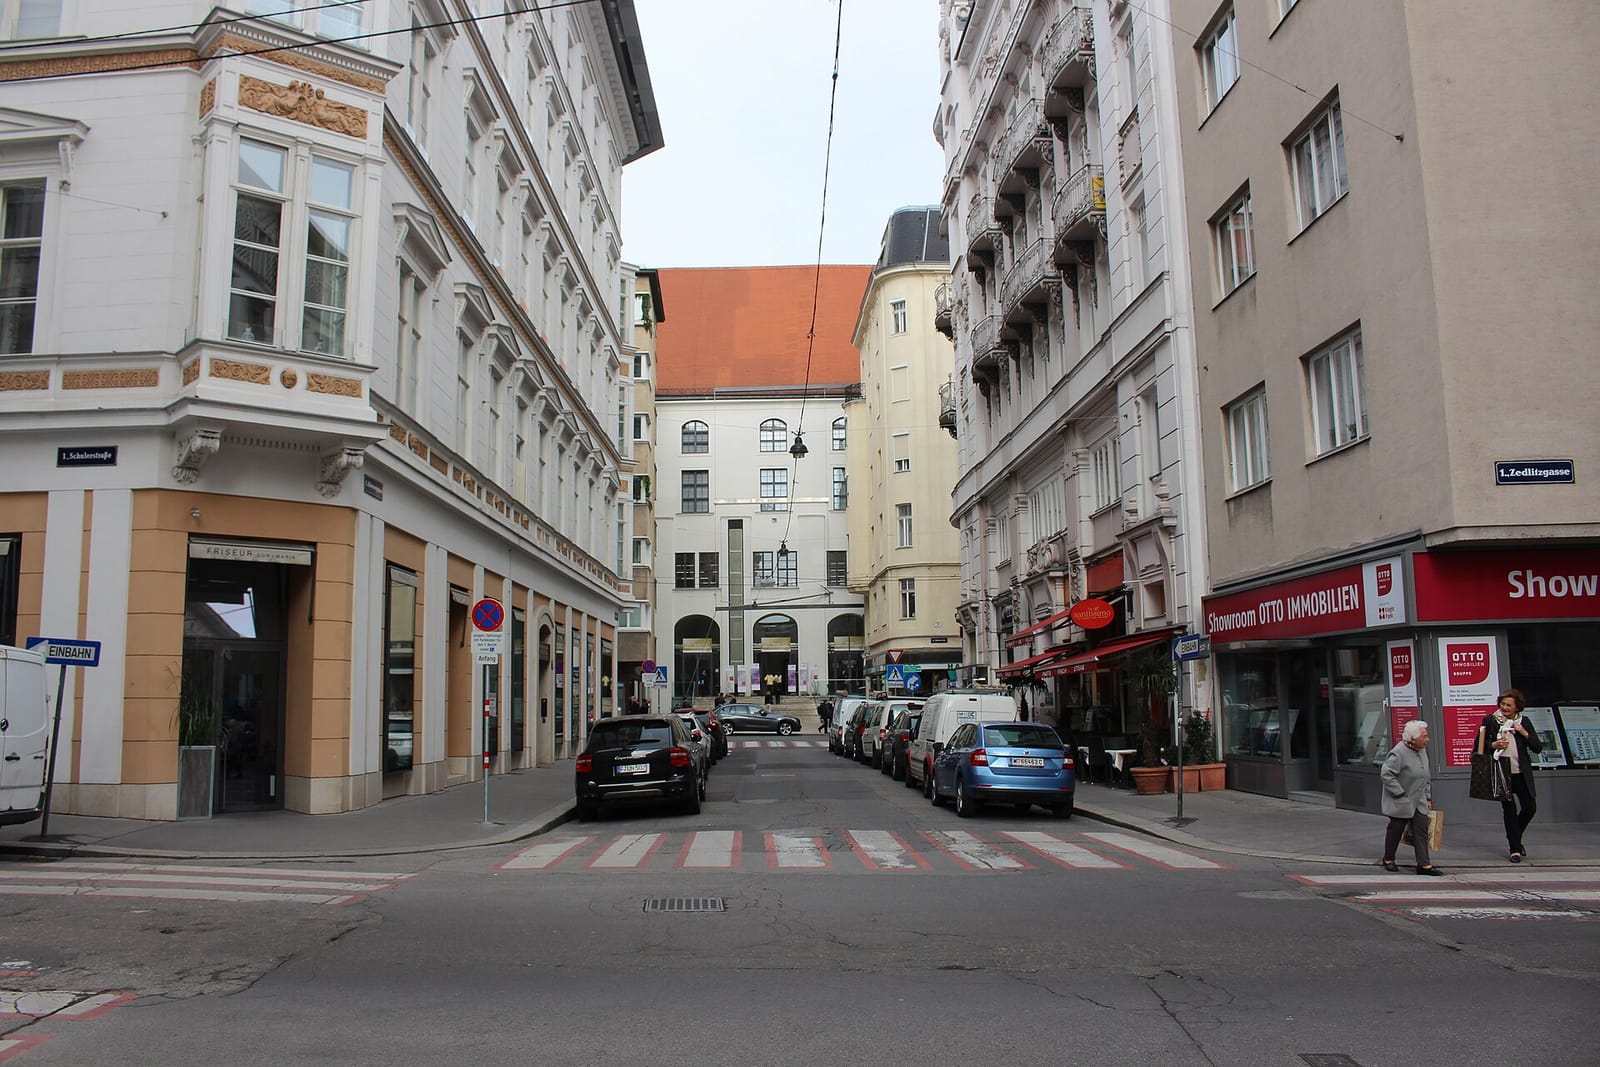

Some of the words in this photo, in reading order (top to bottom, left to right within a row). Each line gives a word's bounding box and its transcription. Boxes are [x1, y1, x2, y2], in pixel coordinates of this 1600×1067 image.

[207, 547, 253, 557] FRISEUR
[1378, 570, 1390, 578] OTTO
[1507, 569, 1599, 598] Show
[1208, 609, 1257, 633] Showroom
[1259, 599, 1284, 625] OTTO
[1287, 583, 1360, 621] IMMOBILIEN
[49, 645, 92, 659] EINBAHN
[1181, 641, 1197, 653] EINBAHN
[1393, 655, 1409, 664] OTTO
[1452, 652, 1484, 661] OTTO
